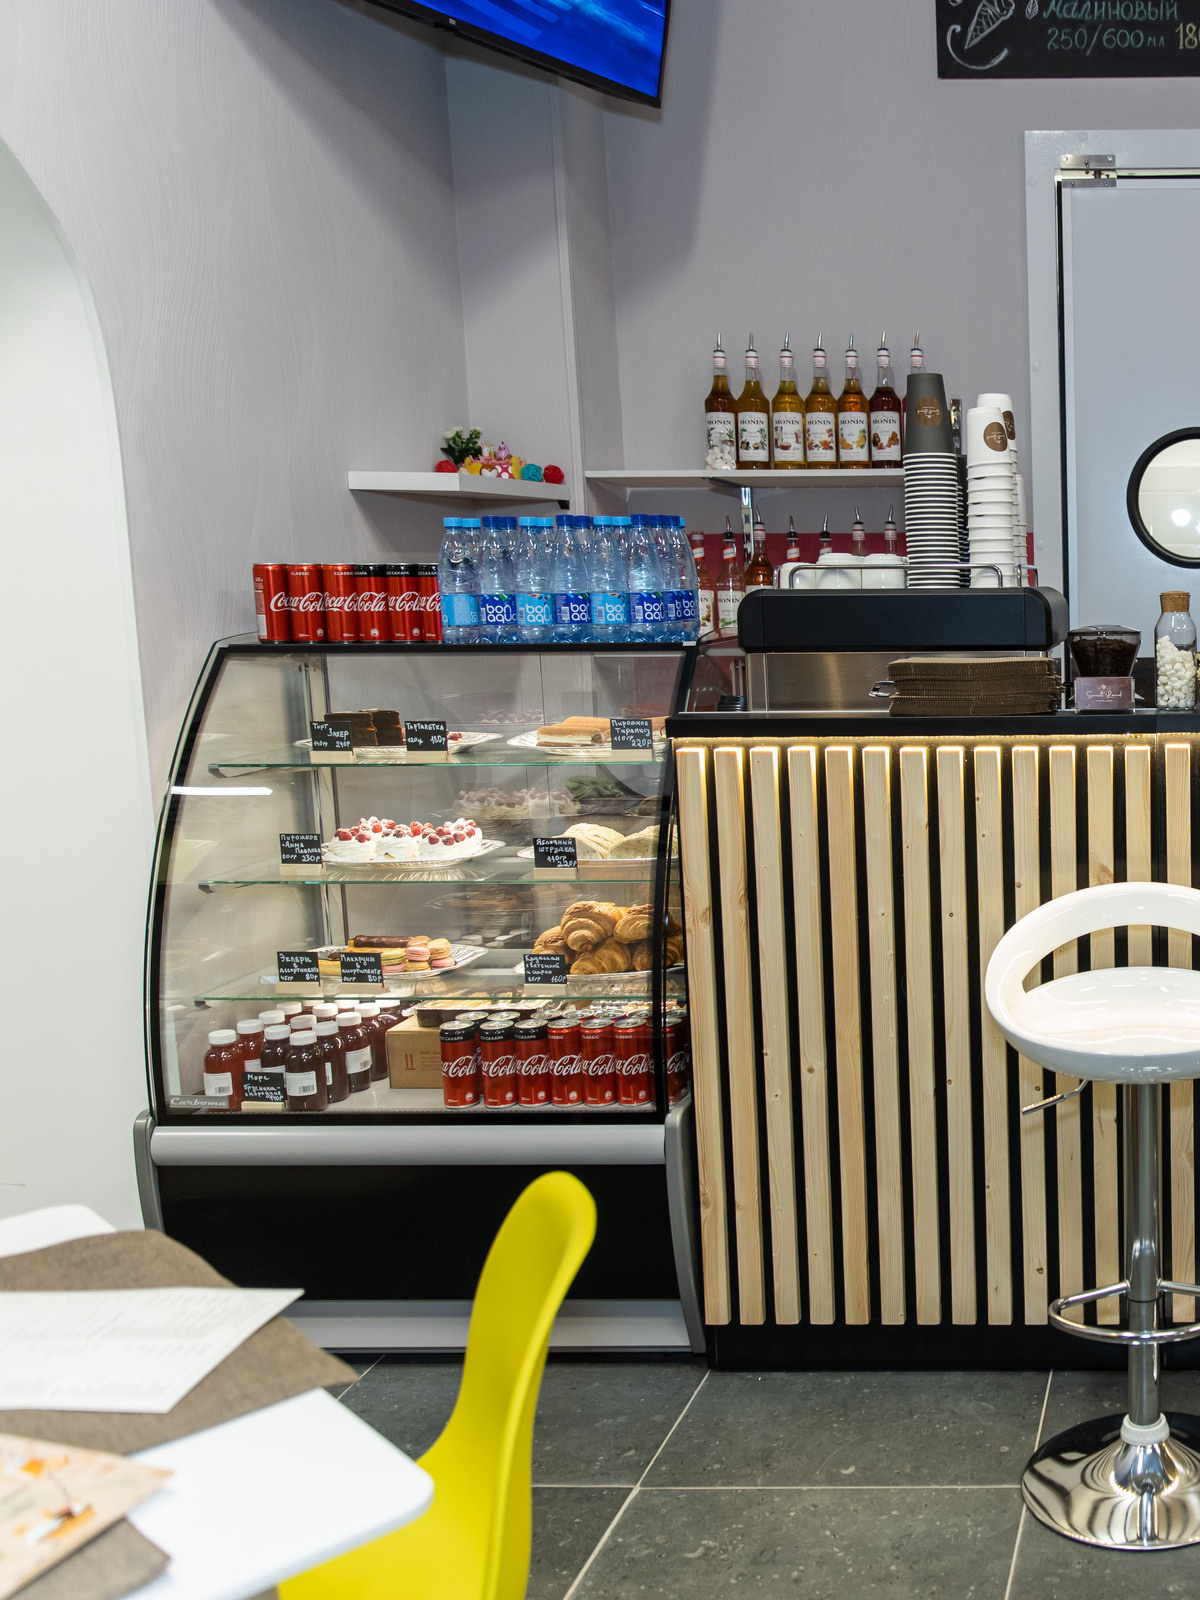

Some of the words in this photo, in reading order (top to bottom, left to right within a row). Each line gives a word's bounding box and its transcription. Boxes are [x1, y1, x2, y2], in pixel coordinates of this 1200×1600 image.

[486, 603, 512, 614] bon
[525, 603, 551, 614] bon
[170, 1097, 228, 1106] Carboma
